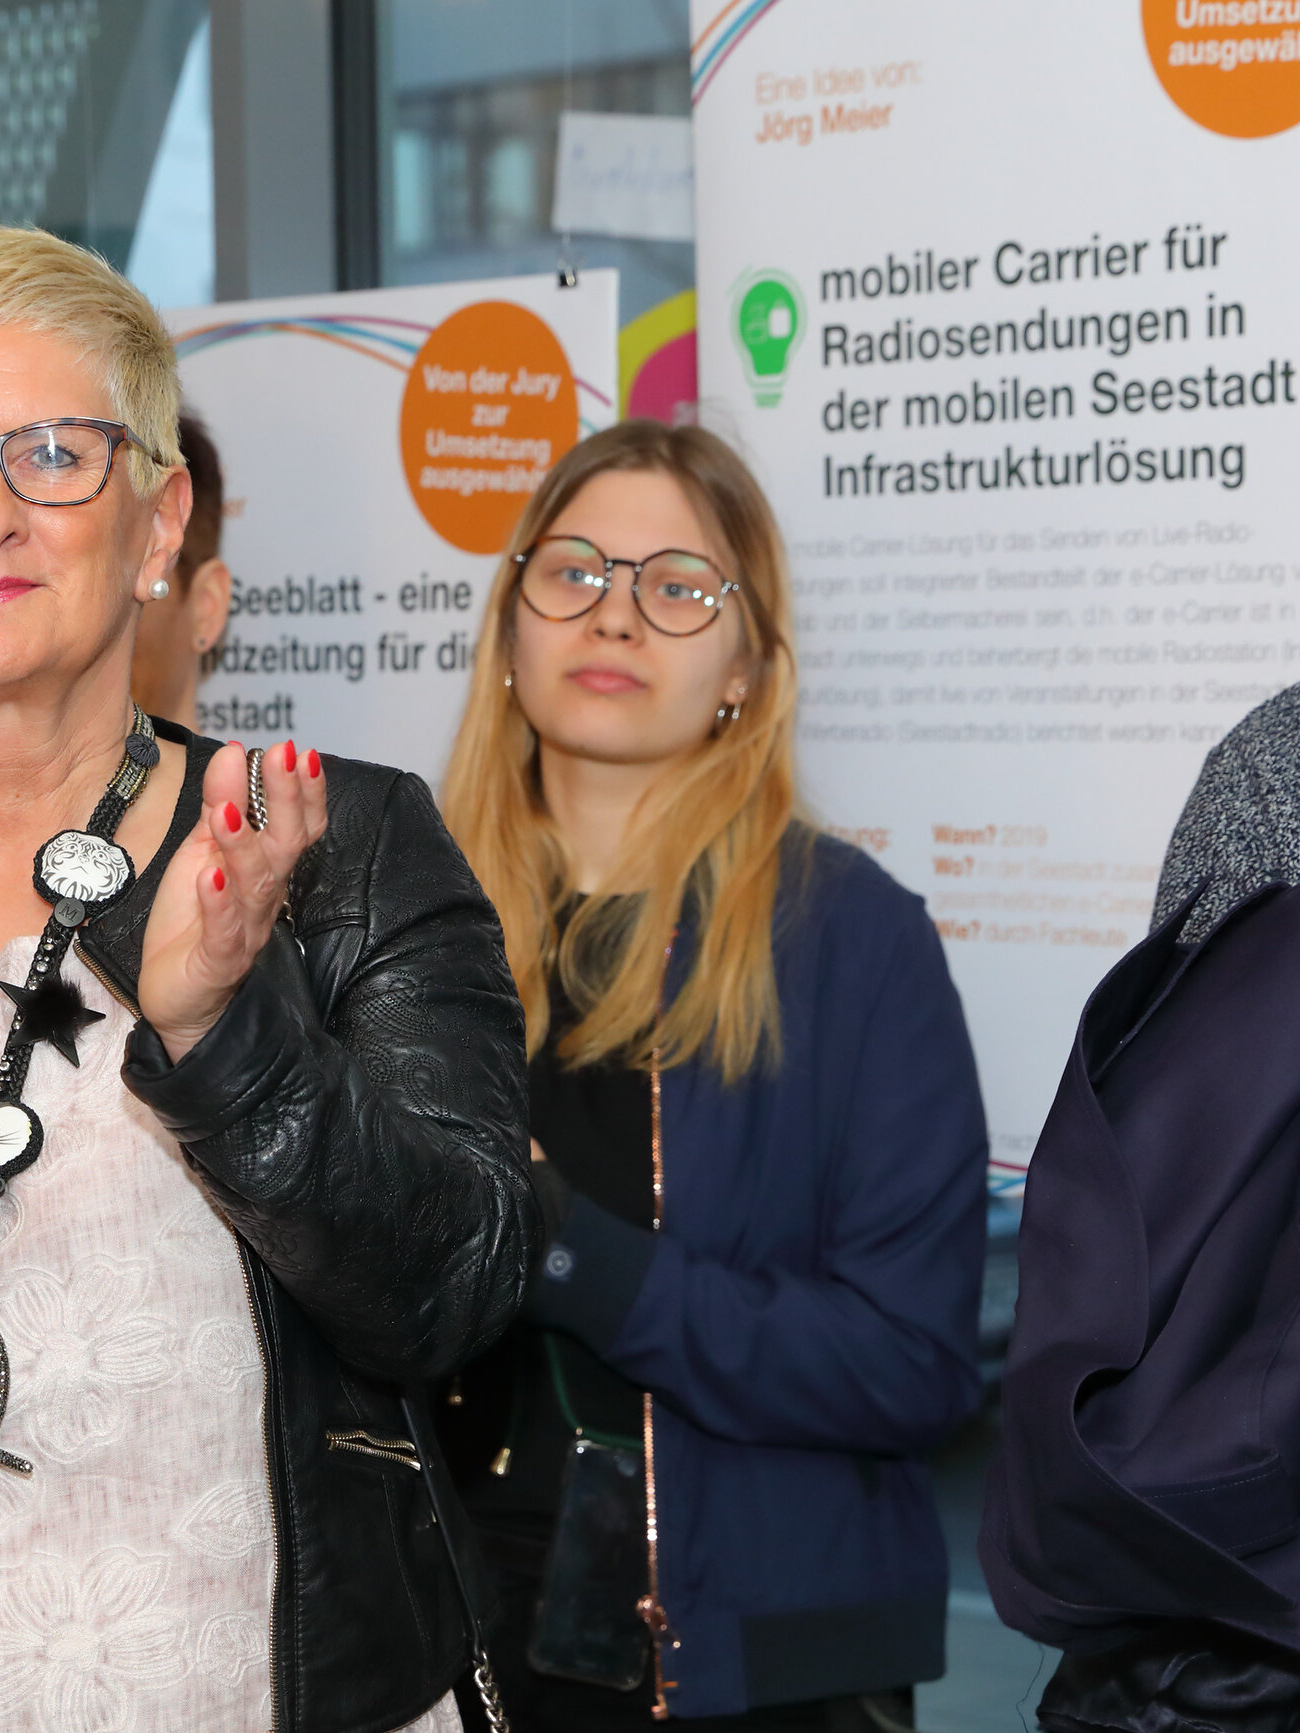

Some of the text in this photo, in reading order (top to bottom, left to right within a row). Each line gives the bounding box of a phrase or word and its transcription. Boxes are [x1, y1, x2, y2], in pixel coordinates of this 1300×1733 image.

[1176, 0, 1300, 28] Umsetzu
[1169, 30, 1300, 71] ausgewä
[755, 58, 925, 106] Eine Idee von:
[754, 98, 894, 146] Jörg Meier
[820, 223, 1228, 304] mobiler Carrier für
[821, 293, 1246, 368] Radiosendungen in
[422, 364, 562, 402] Von der Jury
[822, 359, 1297, 433] der mobilen Seestadt
[471, 403, 510, 427] zur
[425, 428, 552, 468] Umsetzung
[824, 440, 1247, 498] Infrastrukturlösung
[398, 570, 473, 615] eine
[199, 631, 474, 684] ndzeitung für di
[195, 692, 296, 733] estadt
[931, 823, 997, 846] Wann?
